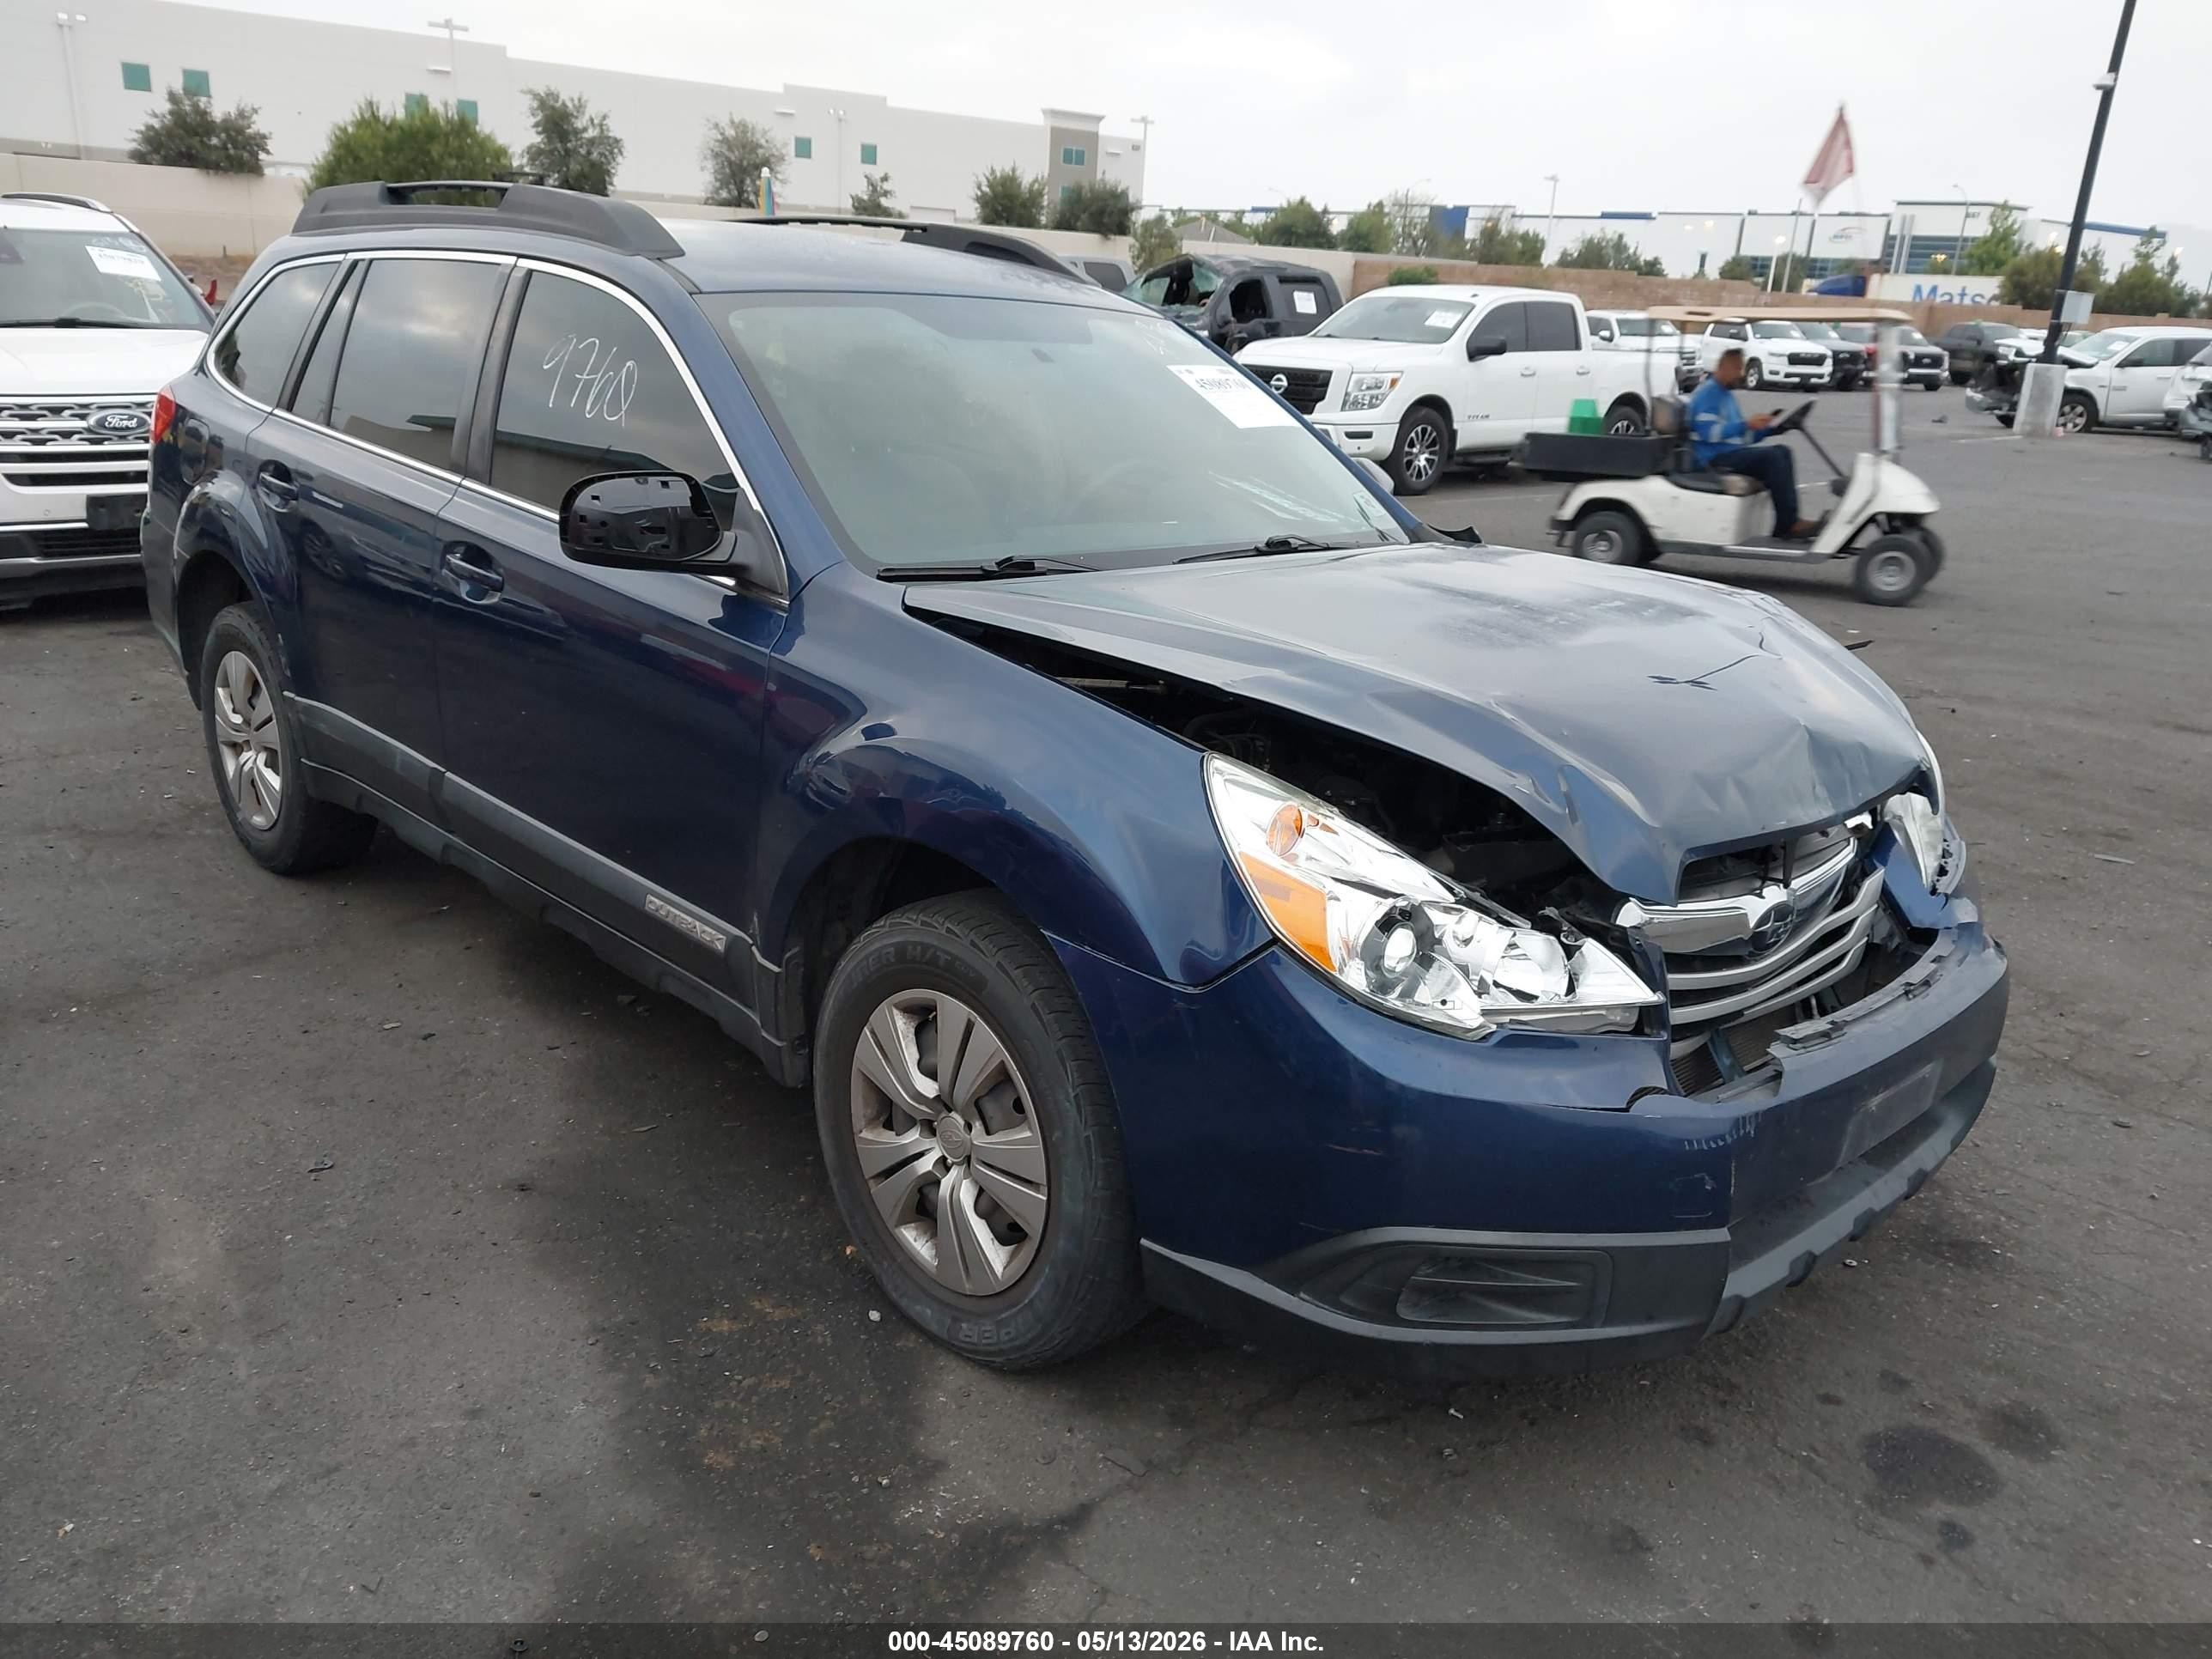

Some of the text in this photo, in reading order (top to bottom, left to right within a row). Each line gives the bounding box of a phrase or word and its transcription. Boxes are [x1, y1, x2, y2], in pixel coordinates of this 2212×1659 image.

[542, 333, 637, 427] 9760
[105, 415, 137, 428] Ford
[646, 894, 726, 952] OUTBACK
